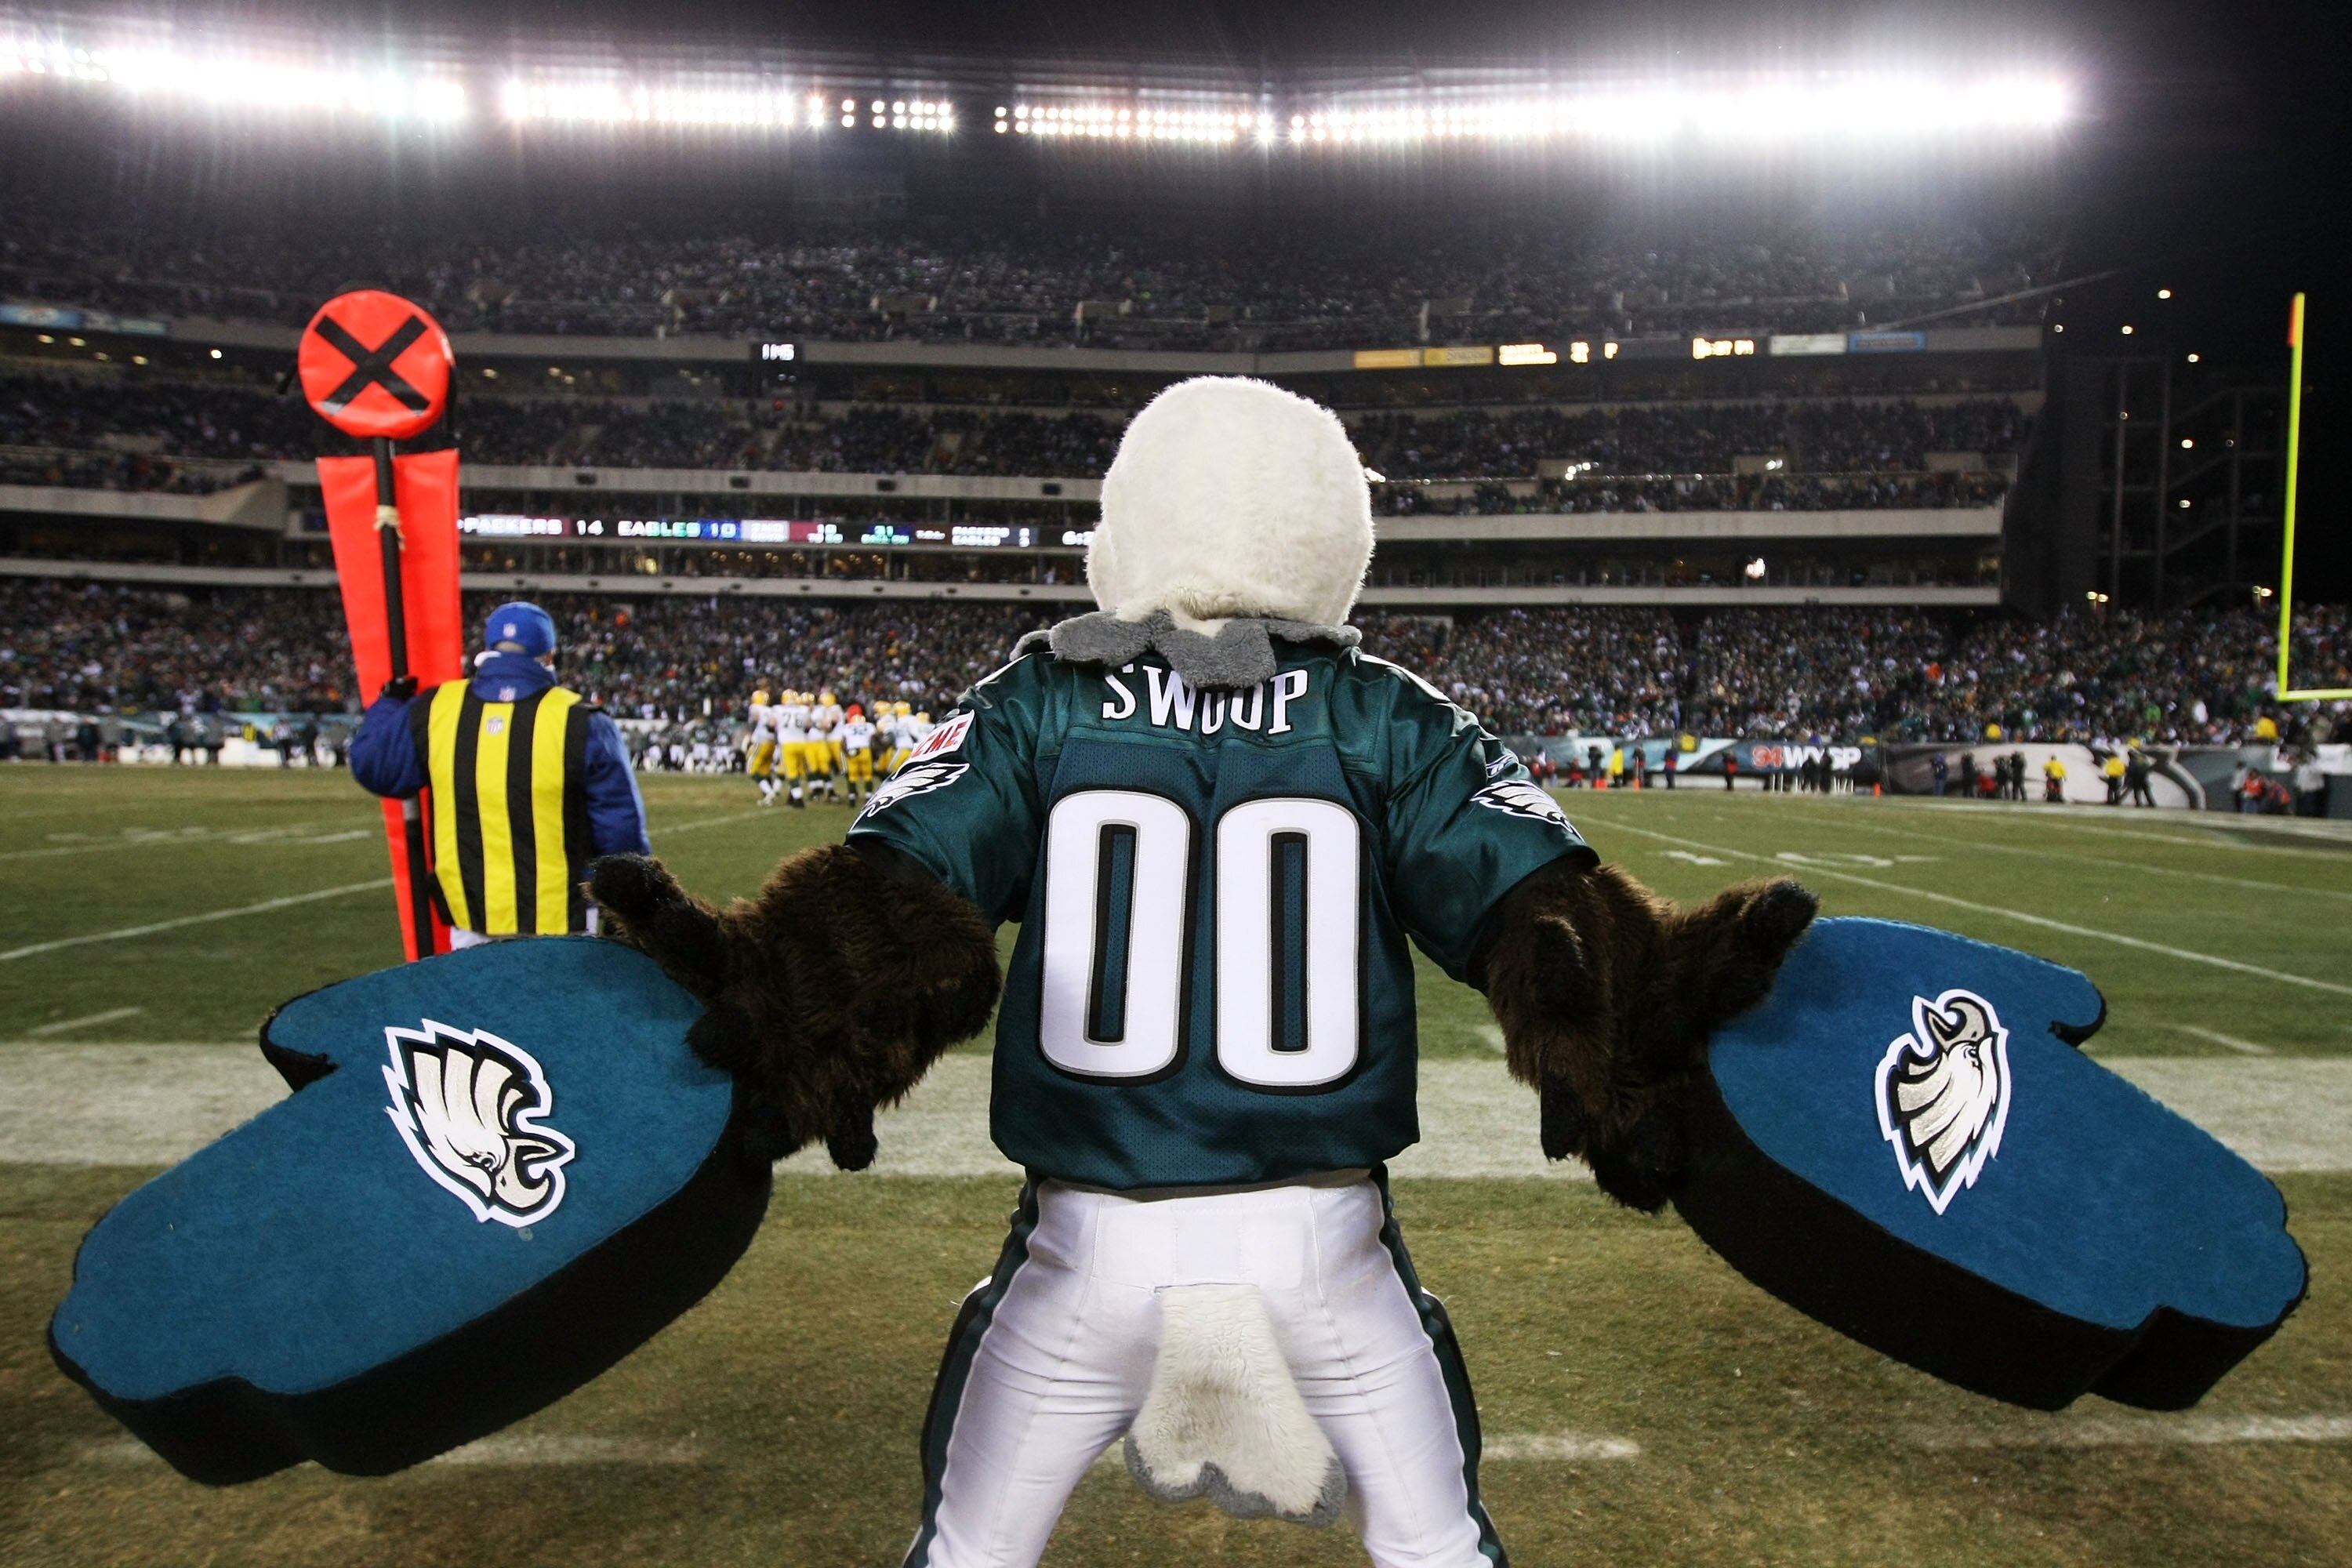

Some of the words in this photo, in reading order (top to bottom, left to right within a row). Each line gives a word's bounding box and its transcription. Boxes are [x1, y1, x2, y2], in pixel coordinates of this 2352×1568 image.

[463, 517, 562, 535] PACKERS
[577, 520, 604, 535] 14
[618, 521, 702, 537] EAGLES
[711, 522, 736, 539] 10
[909, 720, 969, 760] CME
[1039, 789, 1362, 1089] 00
